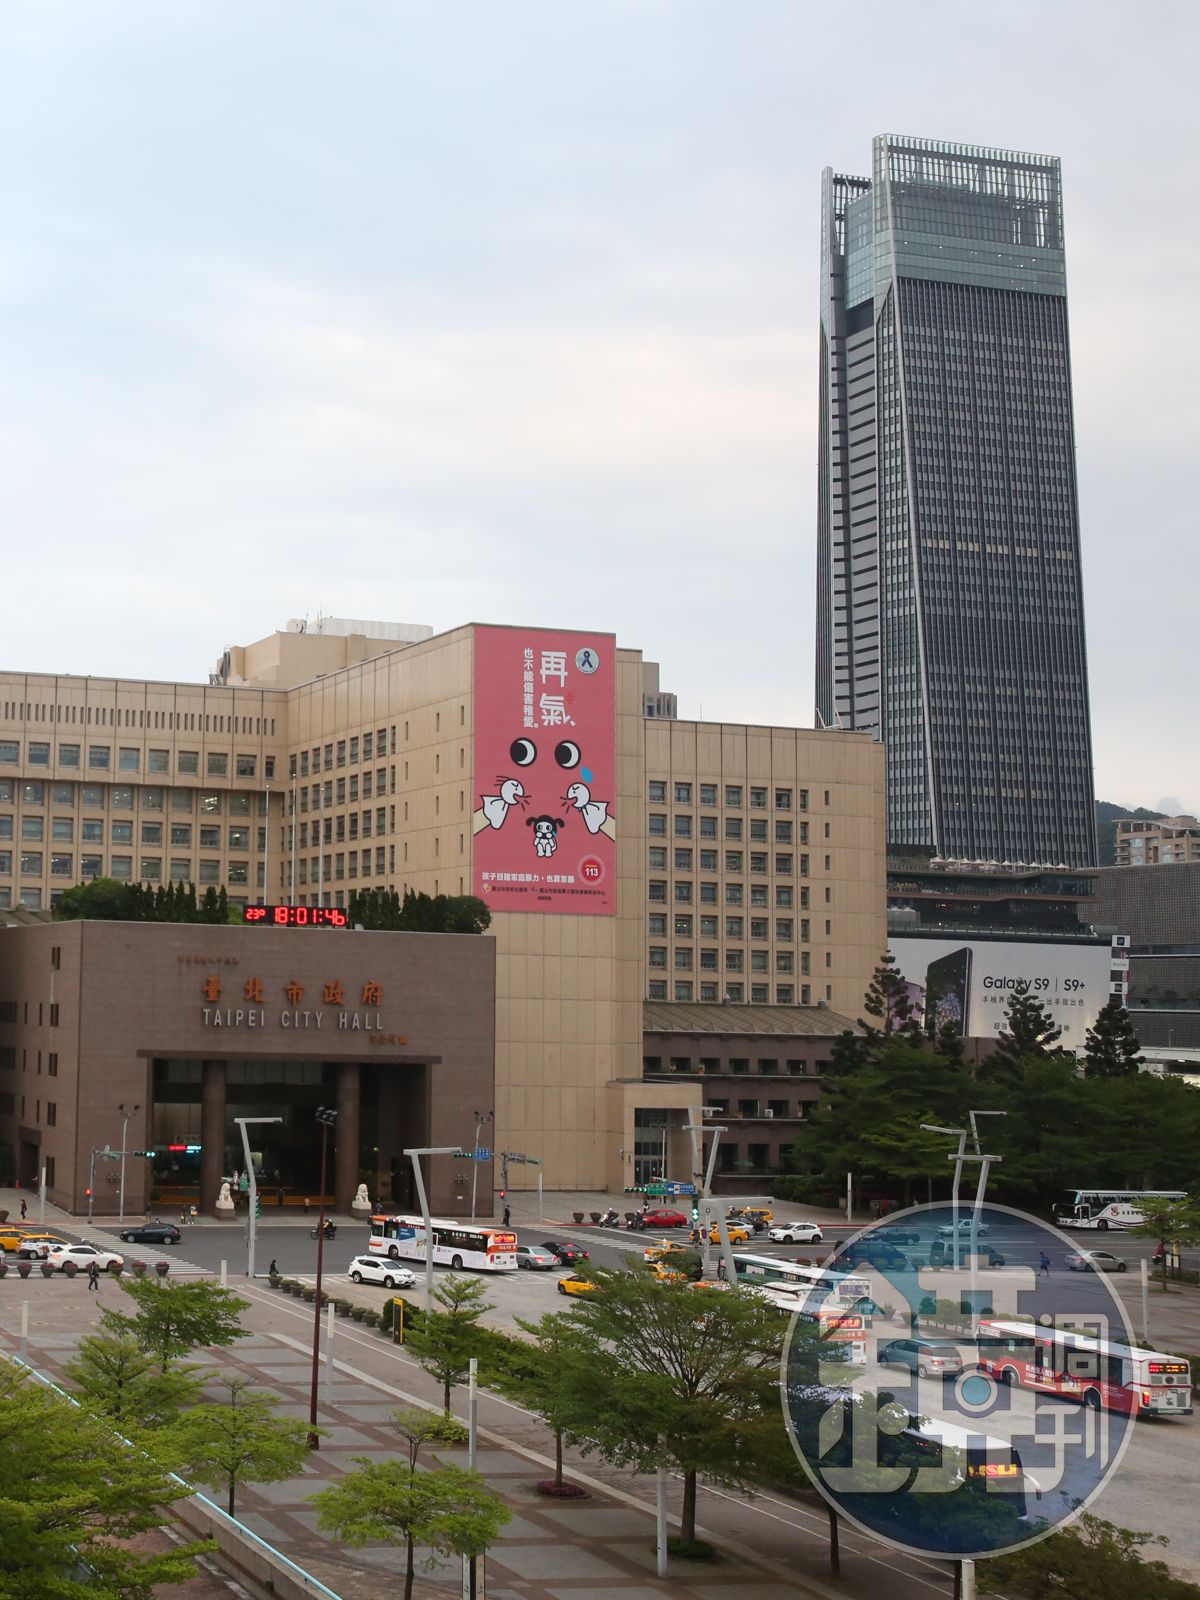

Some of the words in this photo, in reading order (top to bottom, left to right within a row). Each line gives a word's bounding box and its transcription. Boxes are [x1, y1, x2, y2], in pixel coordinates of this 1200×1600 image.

[585, 868, 599, 877] 113
[202, 975, 385, 1005] 臺北市政府
[983, 976, 1032, 993] Galaxy
[1034, 977, 1050, 990] S9
[1063, 978, 1086, 992] S9+
[203, 1008, 266, 1028] TAIPEI
[281, 1011, 324, 1030] CITY
[339, 1013, 384, 1031] HALL
